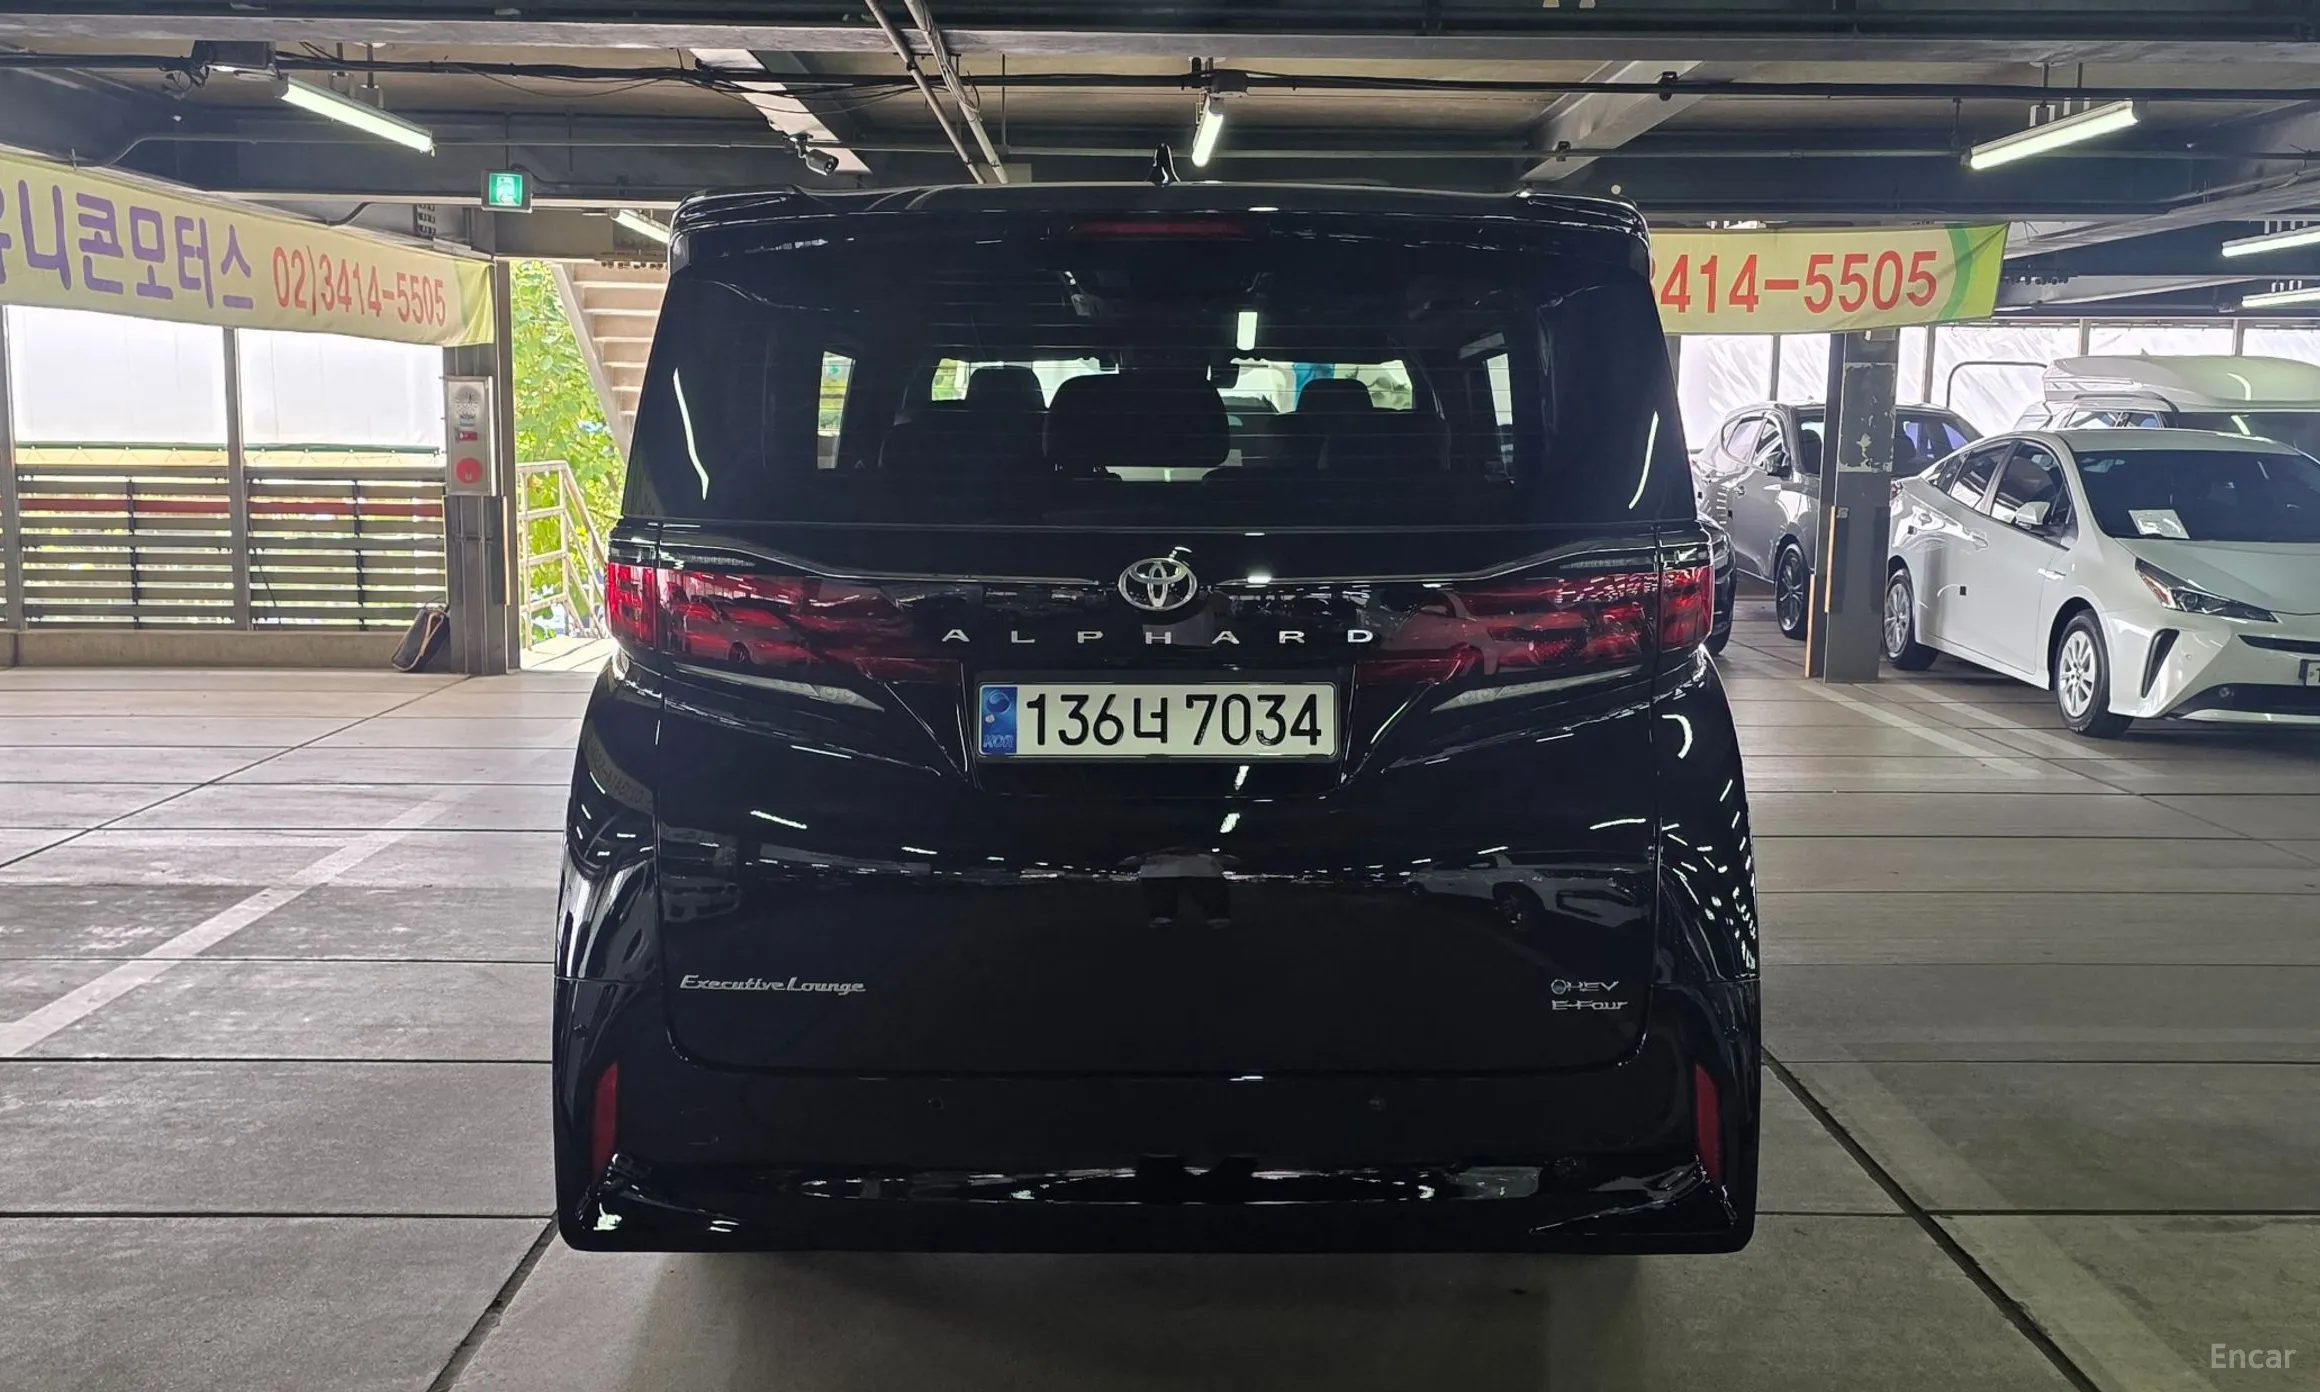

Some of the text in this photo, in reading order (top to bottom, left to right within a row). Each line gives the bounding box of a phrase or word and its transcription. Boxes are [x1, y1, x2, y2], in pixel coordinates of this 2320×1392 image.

[0, 180, 446, 327] 니콘모터스 02)3414-5505
[1651, 250, 1938, 314] 414-5505
[942, 628, 1374, 645] ALPHARD
[1026, 693, 1322, 746] 136너 7034
[1552, 999, 1628, 1011] E-Four
